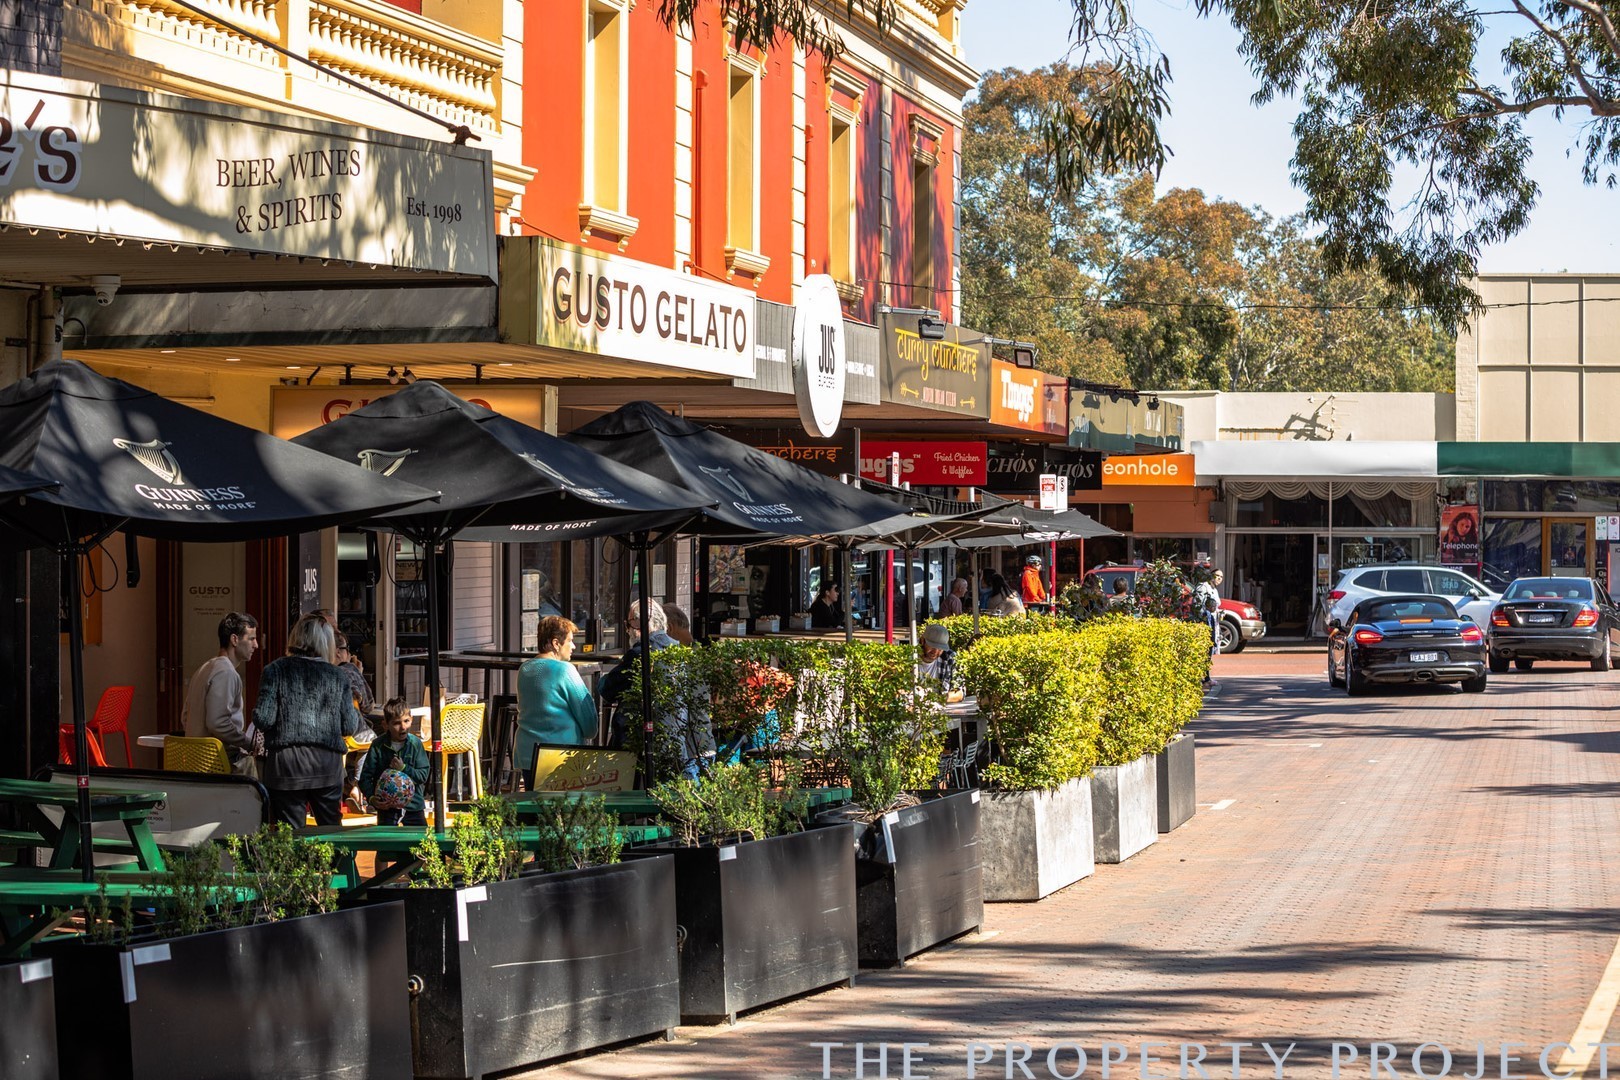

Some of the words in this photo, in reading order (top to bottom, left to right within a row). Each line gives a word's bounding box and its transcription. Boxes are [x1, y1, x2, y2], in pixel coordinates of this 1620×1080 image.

[216, 157, 282, 189] BEER,
[288, 149, 361, 181] WINES
[235, 205, 252, 234] &
[258, 193, 342, 232] SPIRITS
[406, 196, 430, 218] Est.
[433, 203, 462, 224] 1998
[552, 266, 647, 334] GUSTO
[655, 290, 747, 353] GELATO
[818, 324, 835, 375] JUS
[933, 452, 953, 462] Fried
[954, 452, 981, 462] Chicken
[1103, 459, 1178, 475] eonhole
[942, 465, 948, 474] &
[949, 466, 974, 478] Waffles
[135, 484, 245, 501] GUINNESS
[153, 502, 192, 511] MADE
[303, 568, 317, 592] JUS
[189, 586, 231, 595] GUSTO
